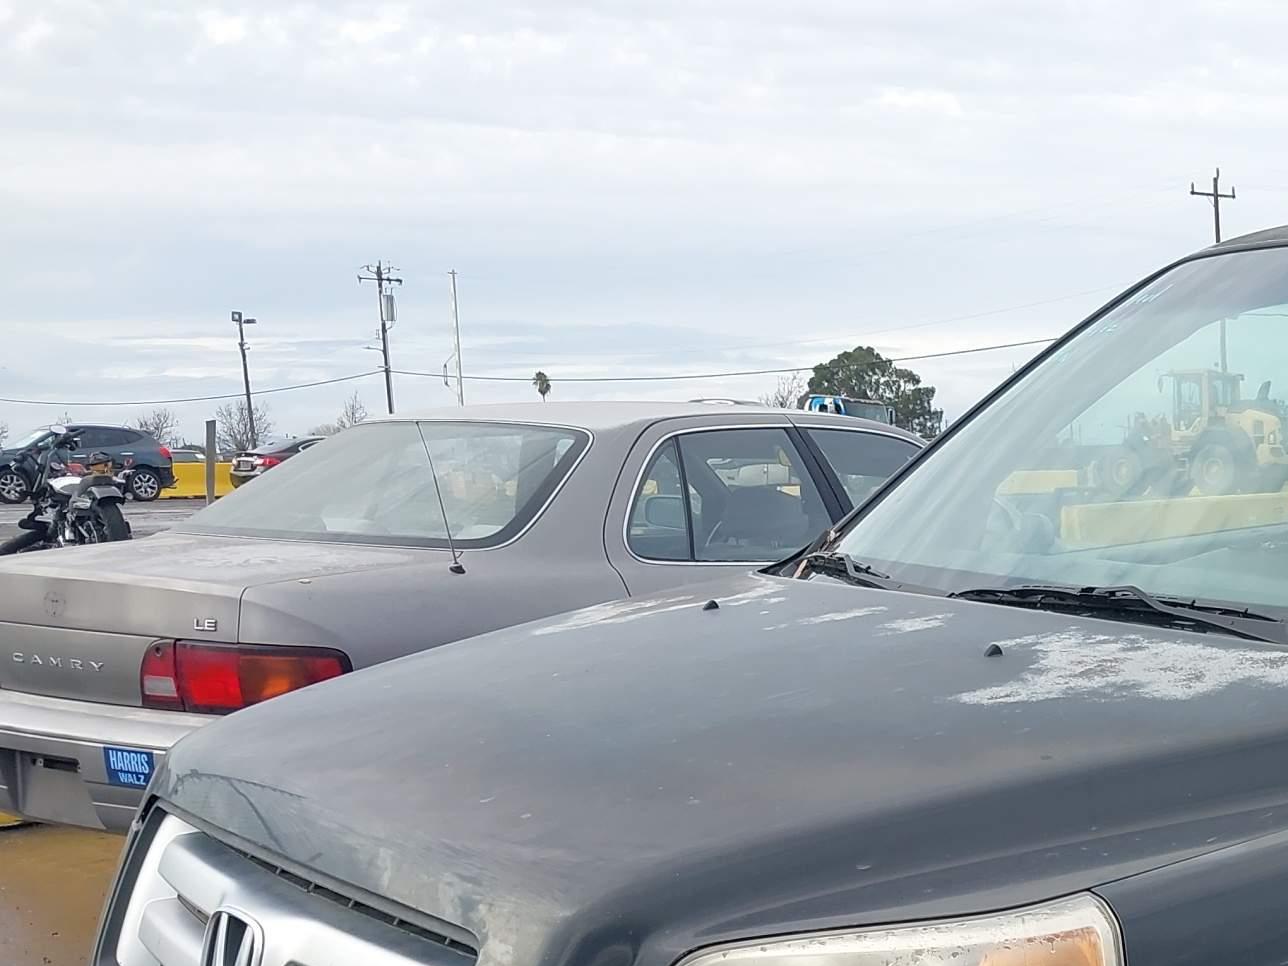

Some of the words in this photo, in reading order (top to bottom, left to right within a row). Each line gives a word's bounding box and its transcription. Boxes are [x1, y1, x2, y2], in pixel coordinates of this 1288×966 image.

[193, 617, 218, 631] LE
[12, 652, 105, 673] CAMRY
[109, 749, 150, 774] HARRIS
[118, 771, 147, 786] WALZ
